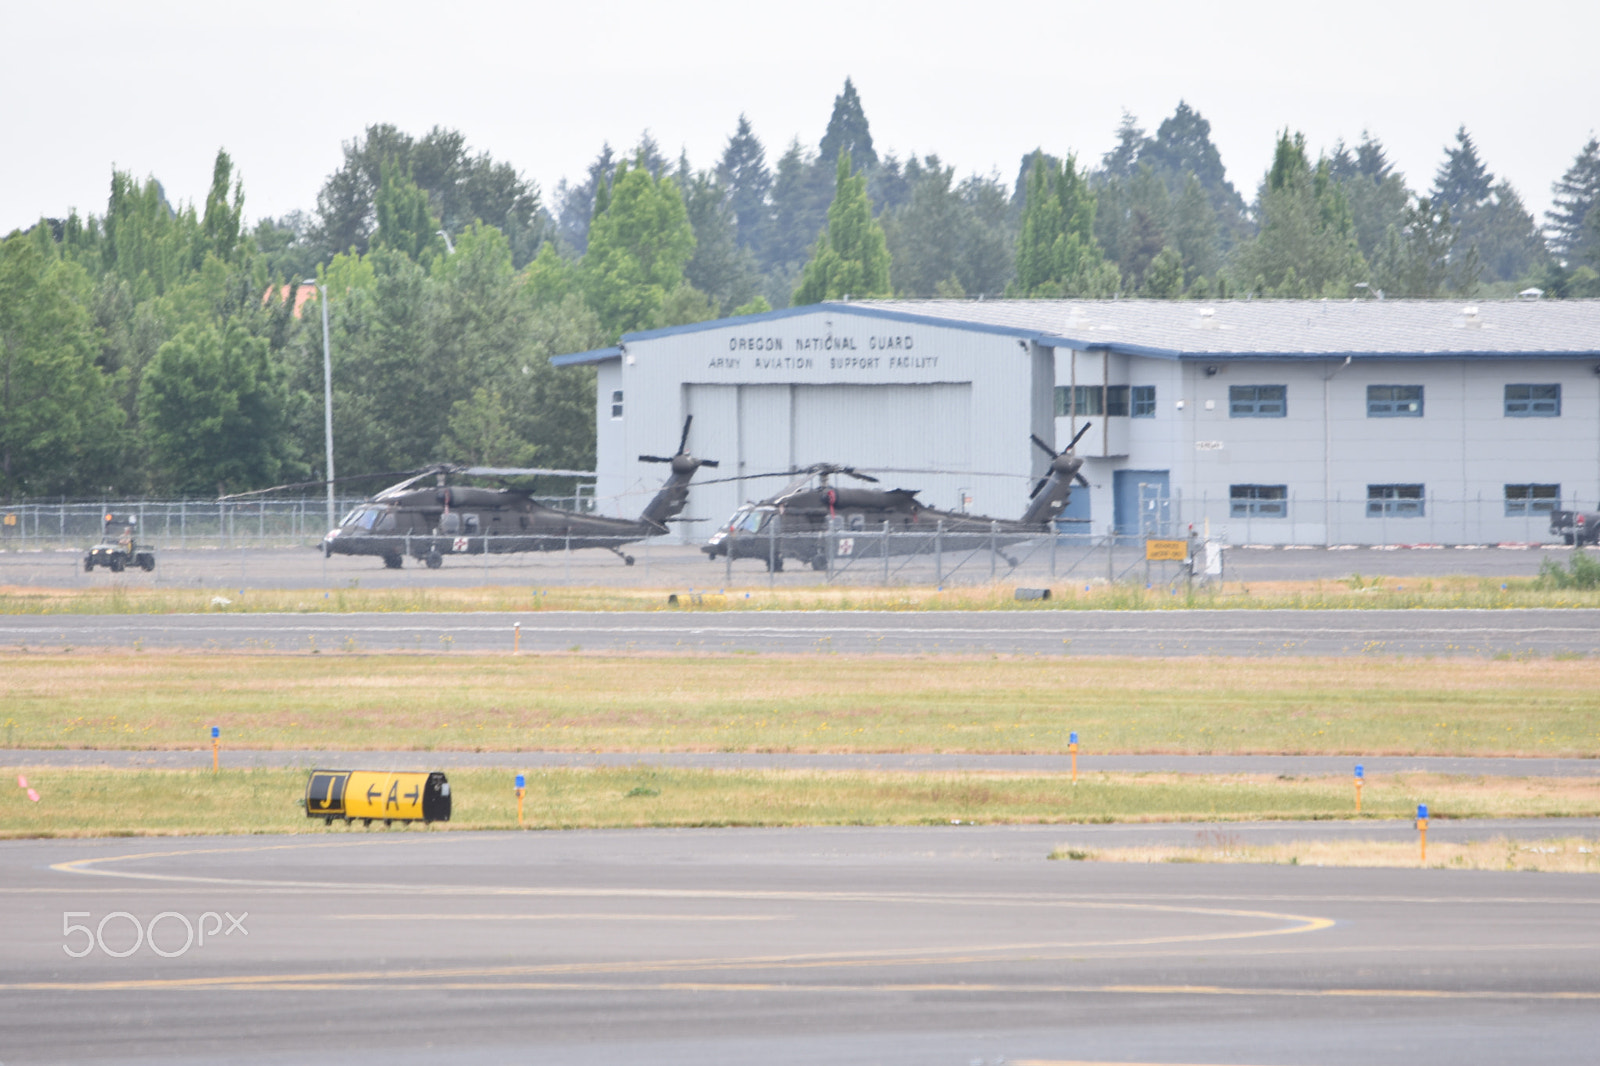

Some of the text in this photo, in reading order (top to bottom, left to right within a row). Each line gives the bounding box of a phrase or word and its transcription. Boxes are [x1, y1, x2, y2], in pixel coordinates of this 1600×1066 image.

[729, 336, 914, 351] OREGON NATIONAL GUARD
[708, 356, 939, 369] ARMY AVIATION SUPPORT FACILITY
[320, 776, 399, 811] J A
